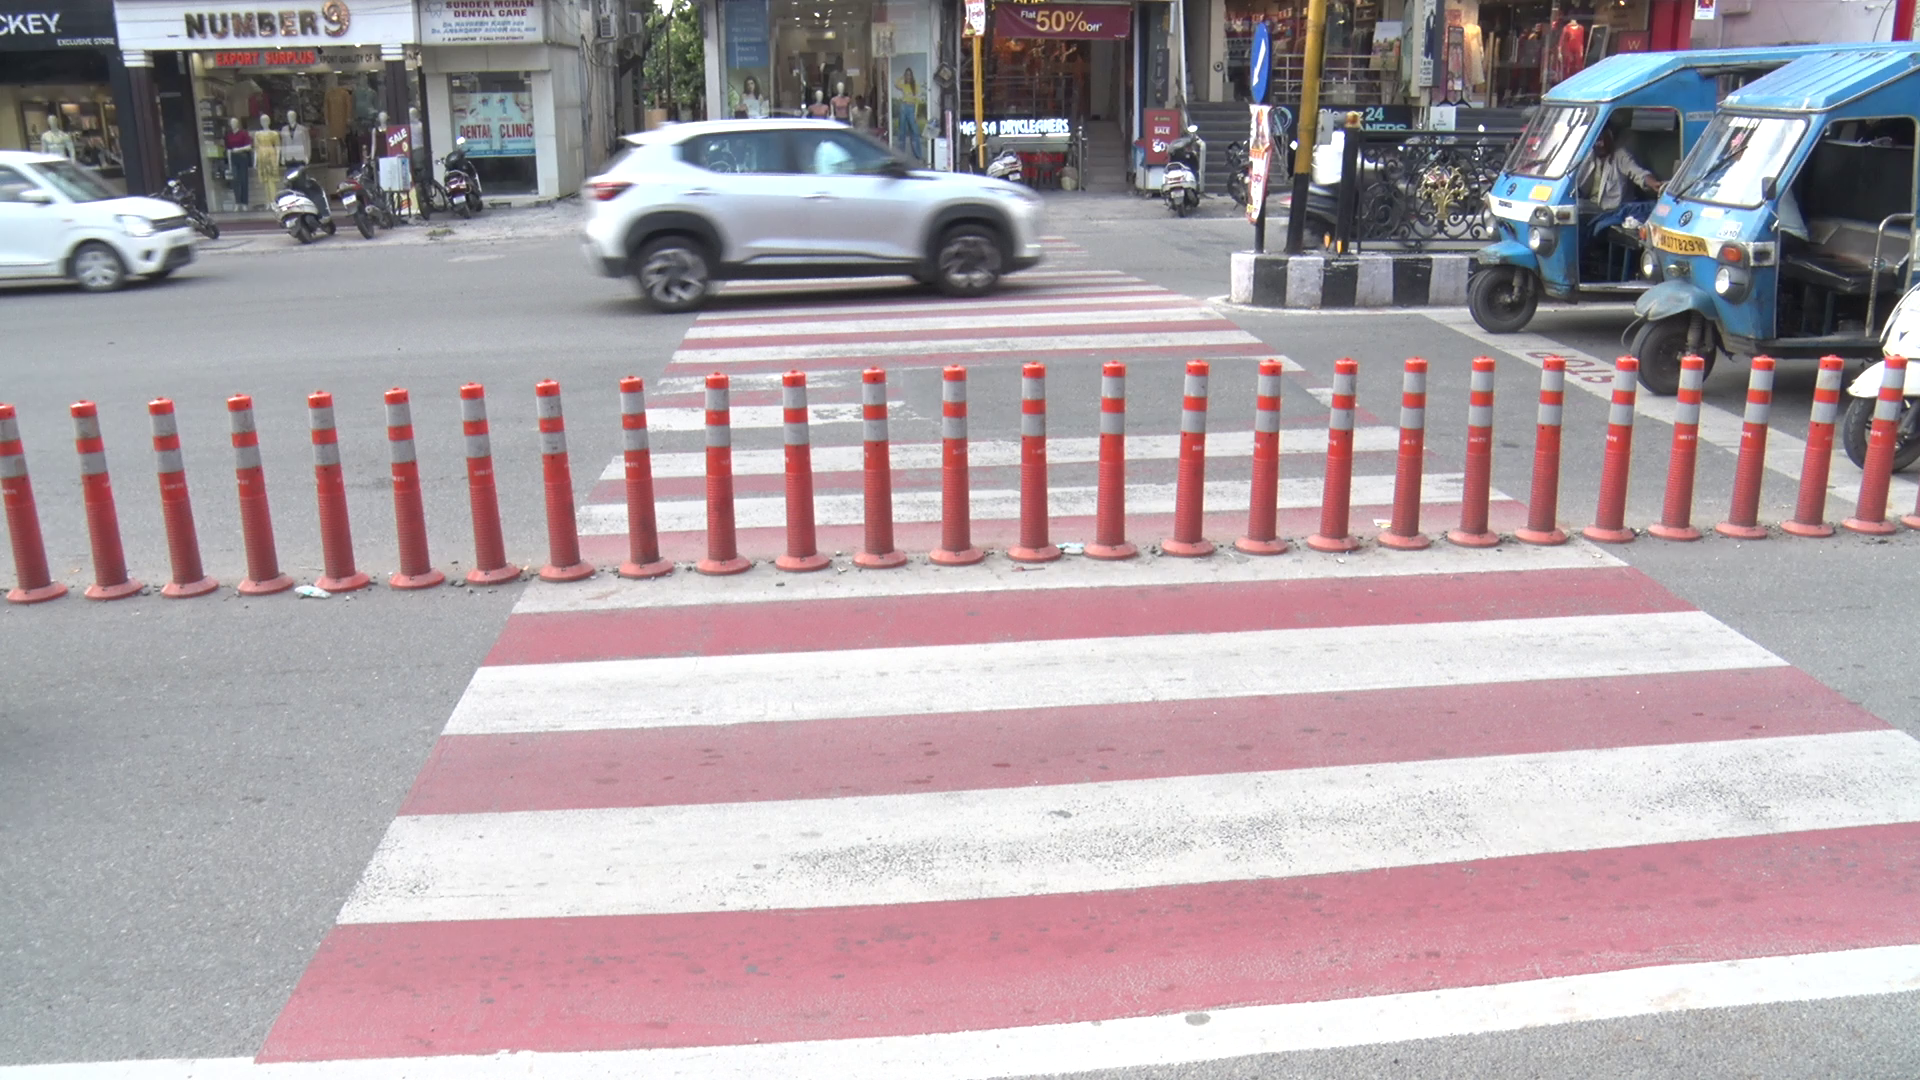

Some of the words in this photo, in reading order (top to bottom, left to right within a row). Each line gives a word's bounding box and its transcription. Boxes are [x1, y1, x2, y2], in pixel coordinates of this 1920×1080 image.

[446, 0, 490, 9] SUNDER
[184, 10, 319, 39] NUMBER
[321, 0, 350, 38] 9
[454, 10, 495, 18] DENTAL
[498, 9, 527, 17] CARE
[1021, 10, 1036, 19] Flat
[1036, 10, 1087, 32] 50%
[57, 38, 92, 46] EXCLUSIVE
[94, 37, 115, 45] STORE
[1628, 40, 1641, 50] W
[216, 52, 259, 66] EXPORT
[264, 51, 316, 65] SURPLUS
[1365, 107, 1384, 121] 24
[460, 124, 493, 139] DENTAL
[500, 123, 533, 138] CLINIC
[1000, 119, 1069, 135] DRYCLEANERS
[1154, 126, 1170, 135] SALE
[388, 128, 407, 146] SALE
